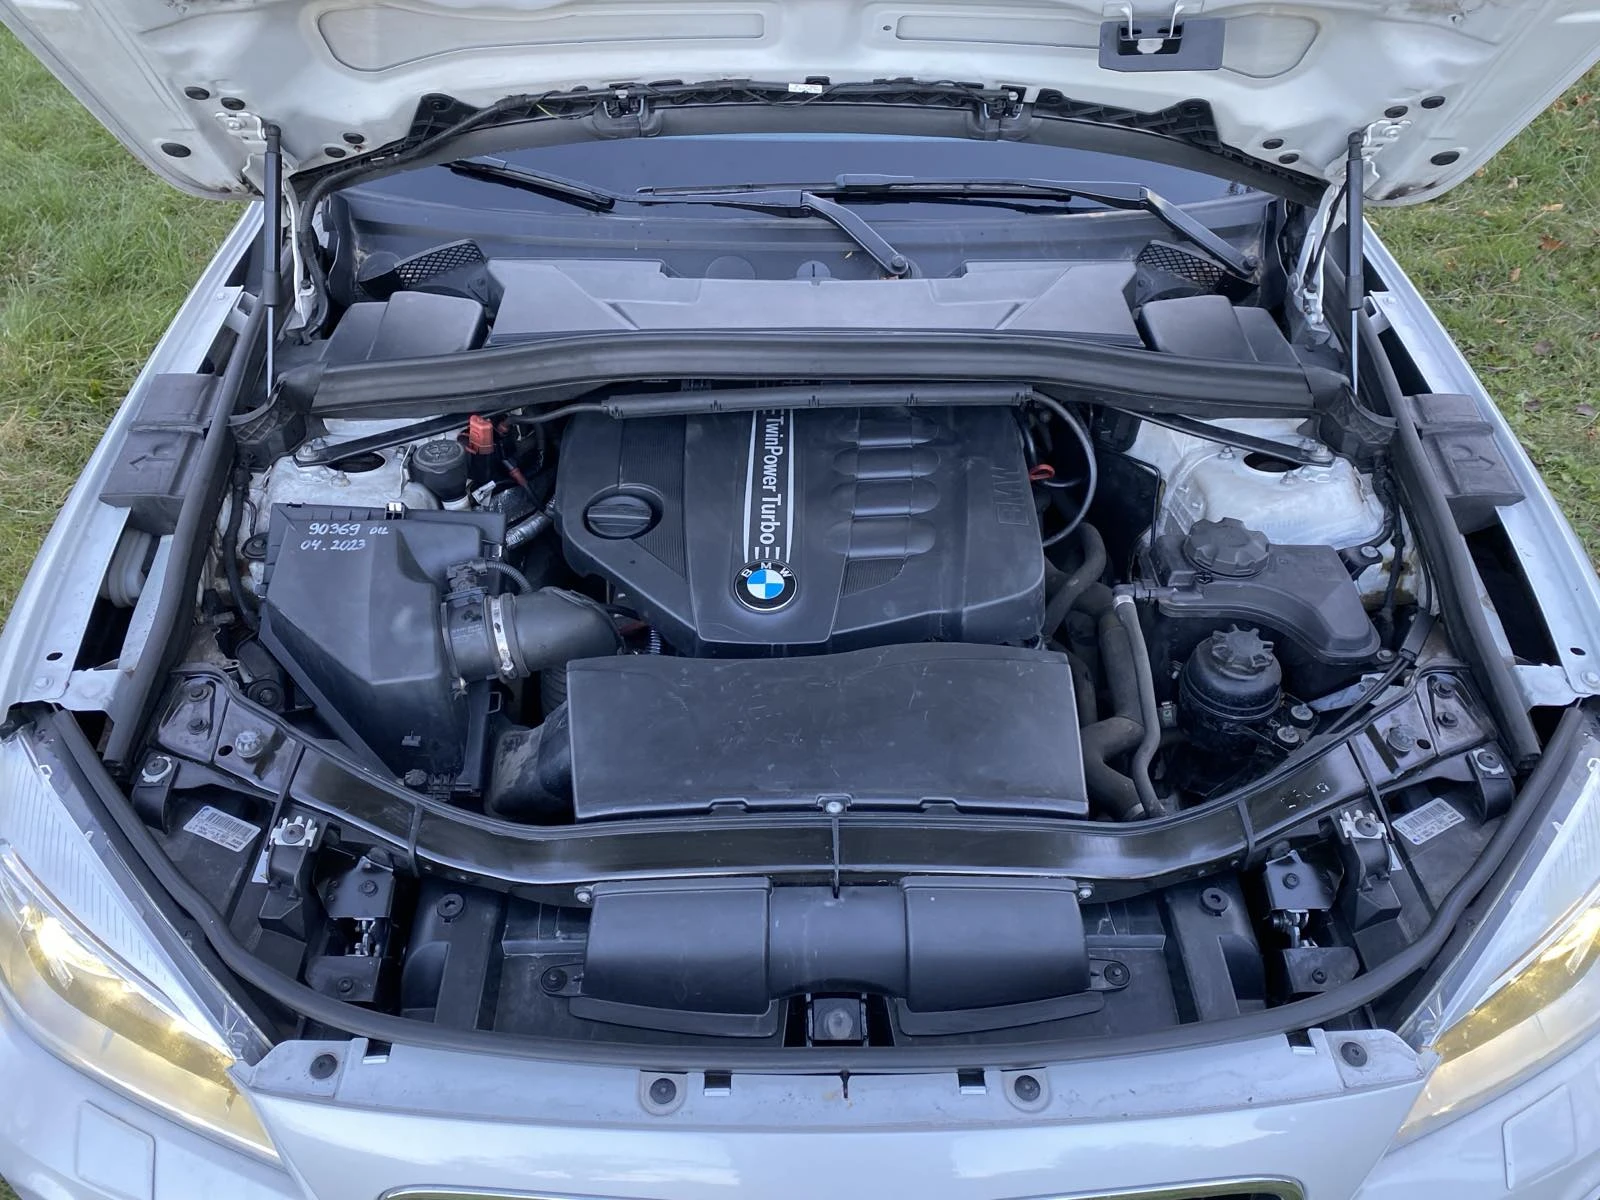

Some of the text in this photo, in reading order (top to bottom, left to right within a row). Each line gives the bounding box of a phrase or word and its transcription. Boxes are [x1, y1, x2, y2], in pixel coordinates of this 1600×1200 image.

[760, 416, 785, 545] TwinPower Turbo
[308, 522, 361, 536] 90369
[741, 562, 792, 578] BMW
